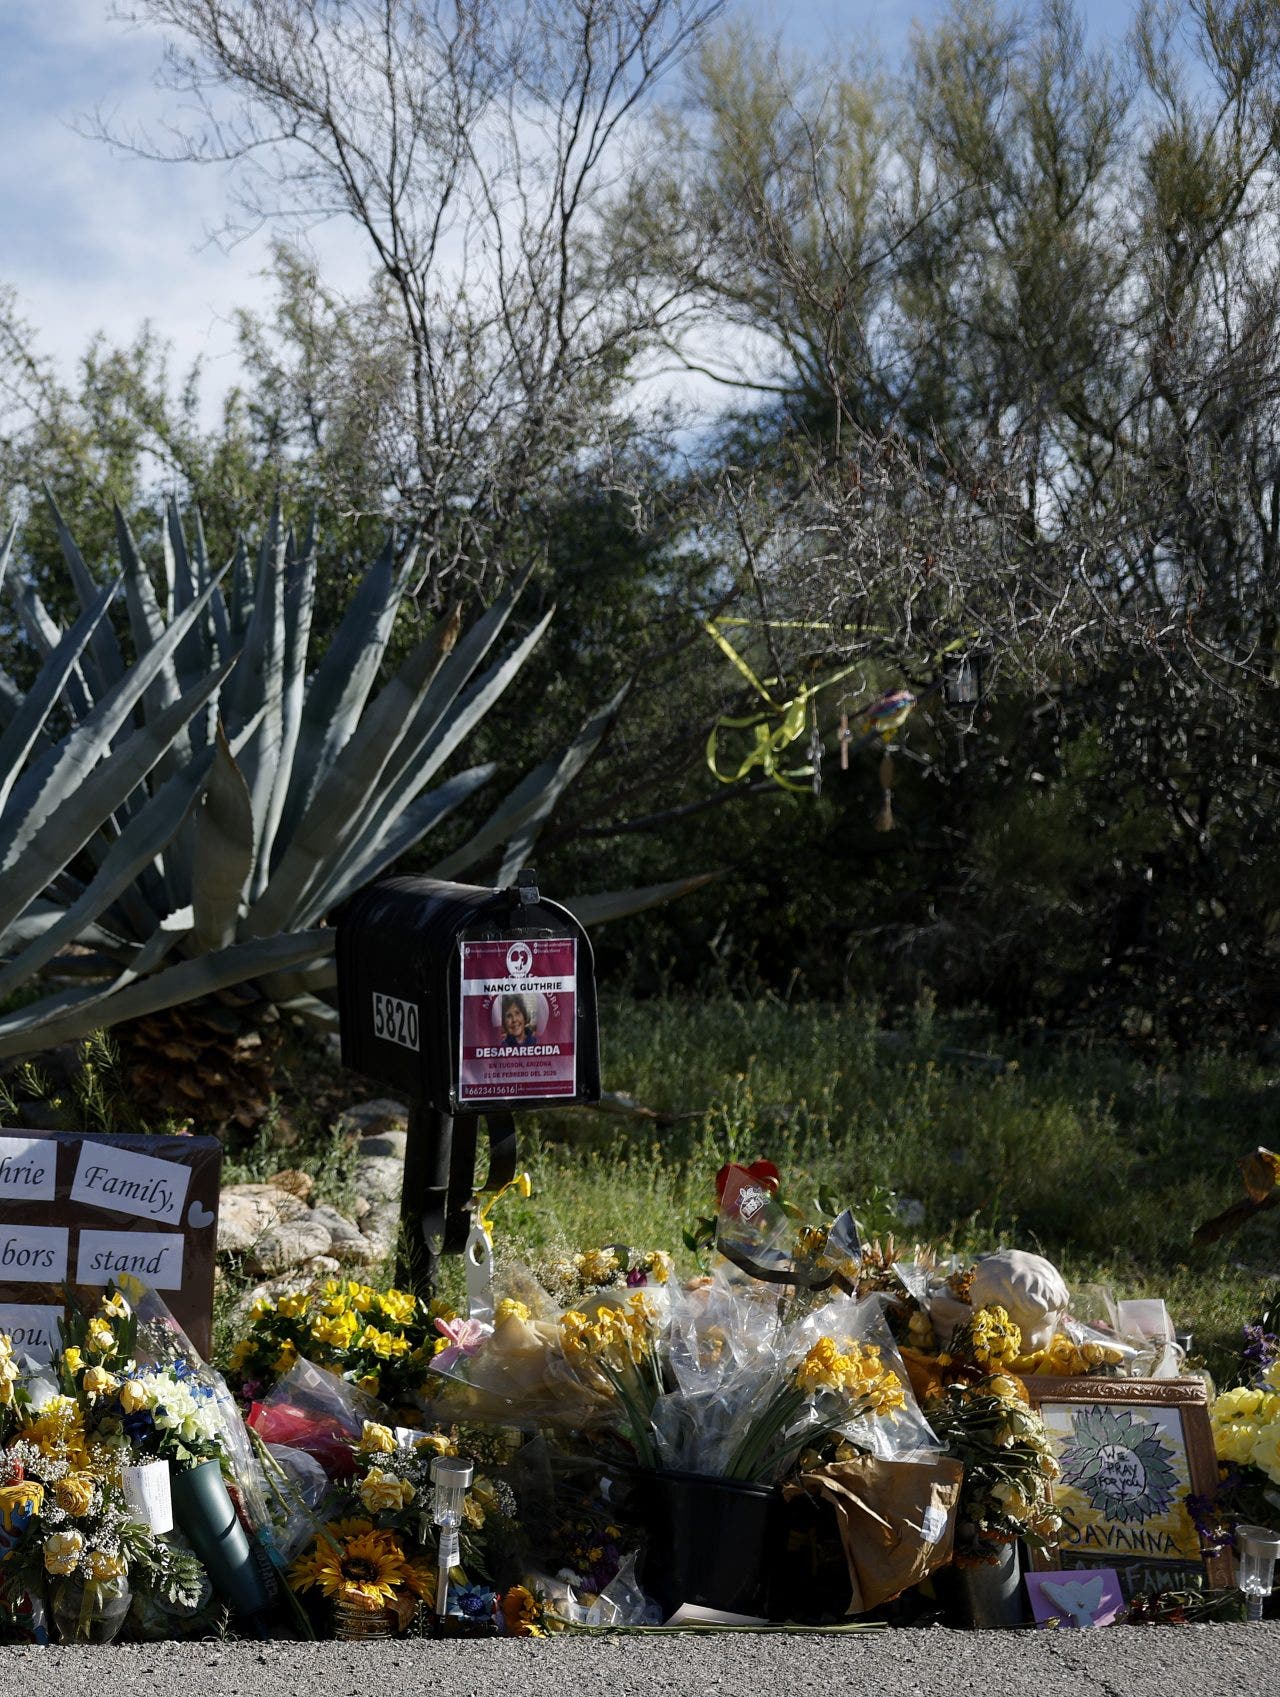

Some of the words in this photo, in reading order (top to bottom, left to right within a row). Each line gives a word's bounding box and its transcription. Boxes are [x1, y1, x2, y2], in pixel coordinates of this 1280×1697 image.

[483, 984, 518, 992] NANCY
[520, 982, 562, 991] GUTHRIE
[375, 994, 418, 1047] 5820
[475, 1045, 561, 1058] DESAPARECIDA
[84, 1165, 175, 1214] Family,
[90, 1247, 170, 1274] stand
